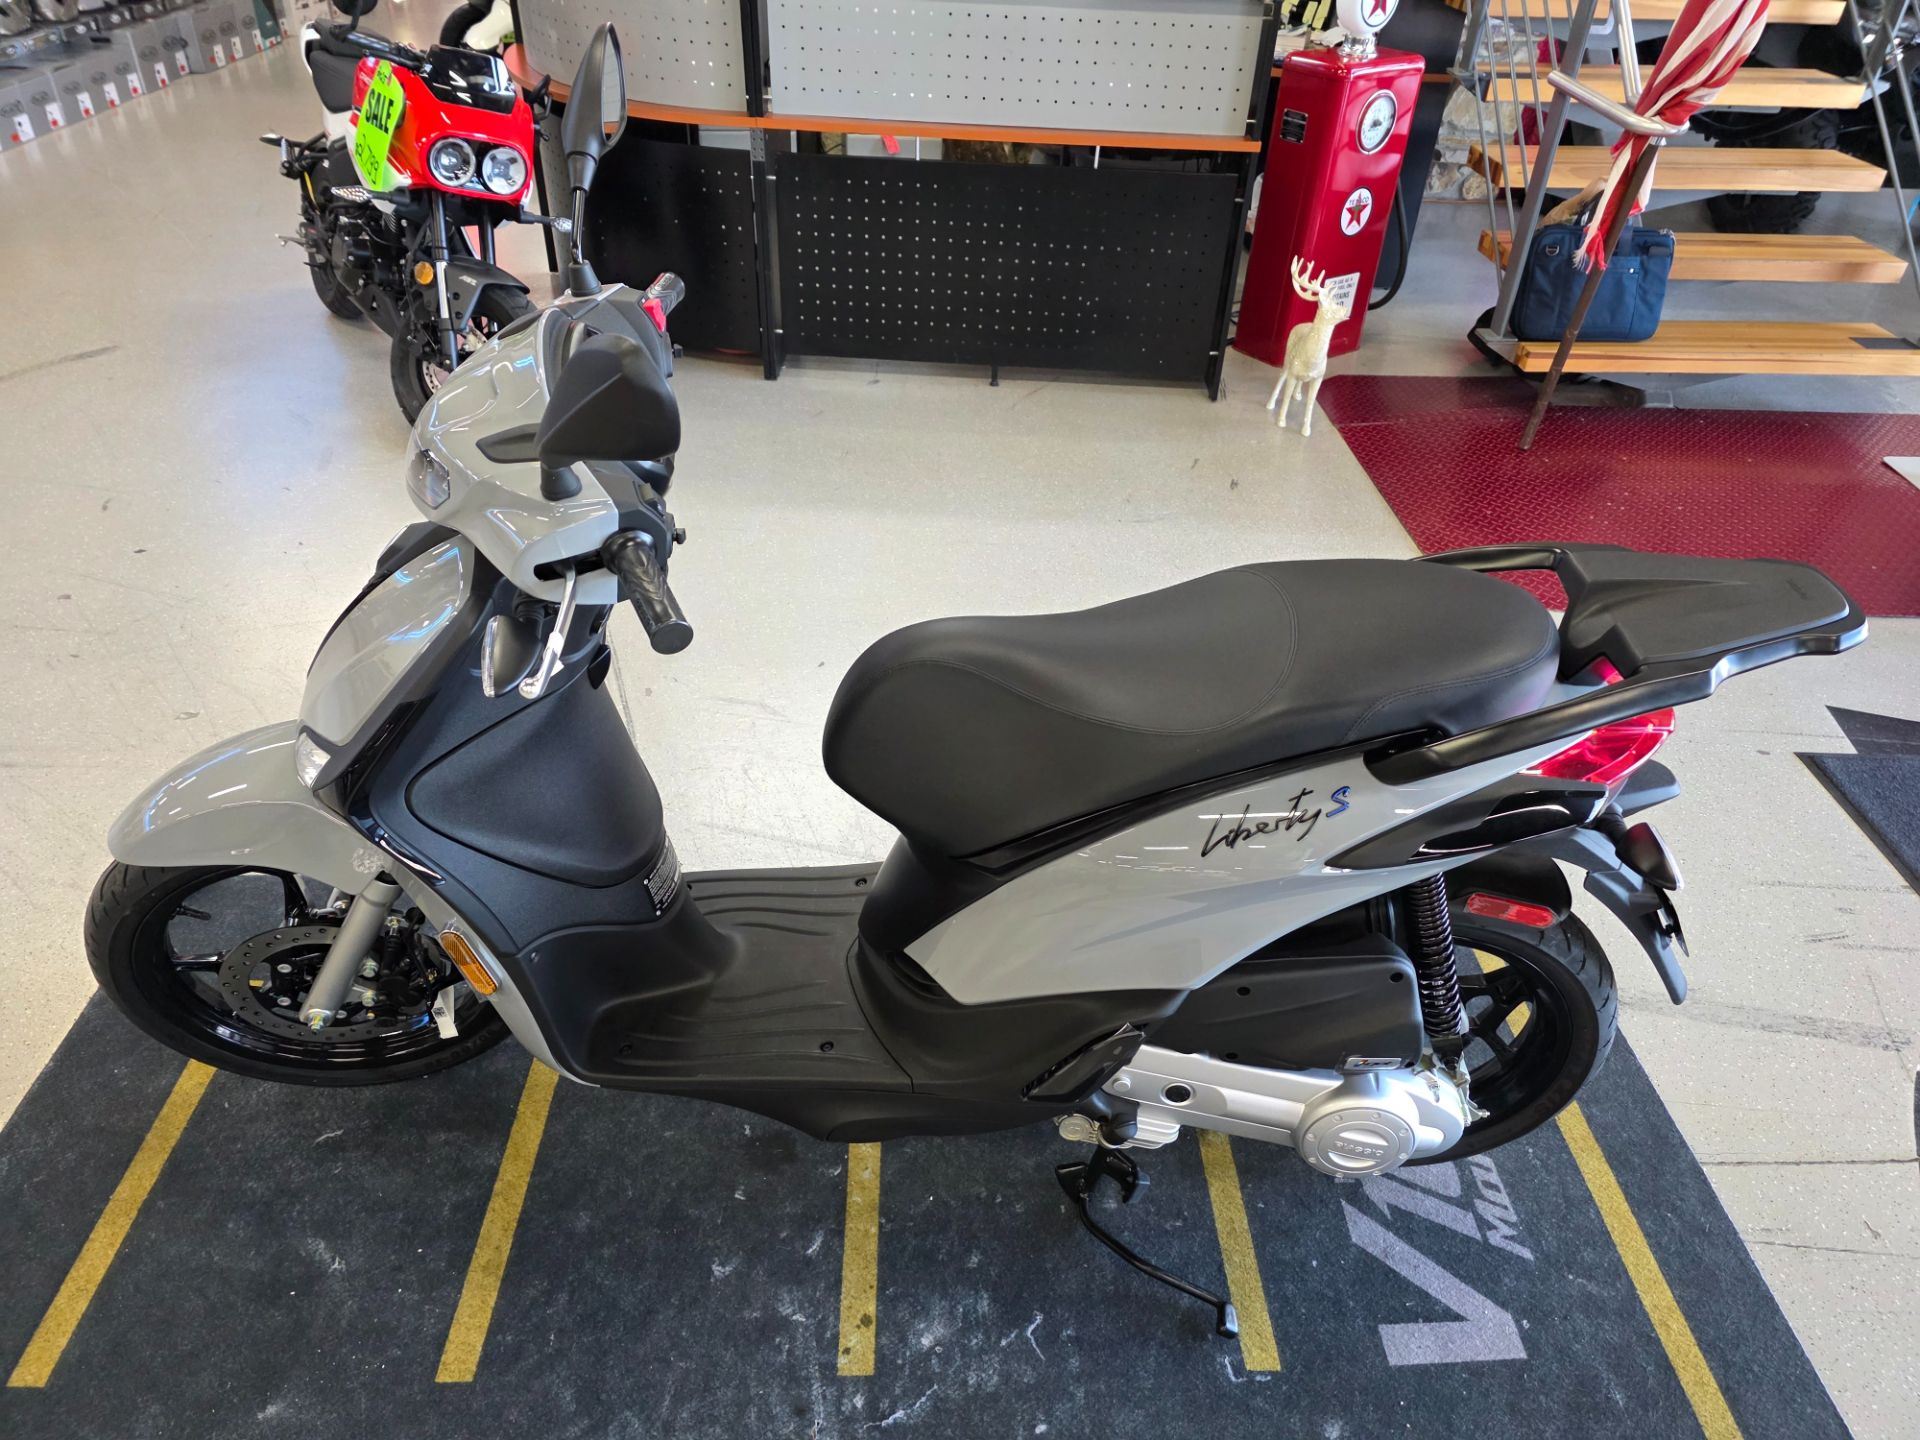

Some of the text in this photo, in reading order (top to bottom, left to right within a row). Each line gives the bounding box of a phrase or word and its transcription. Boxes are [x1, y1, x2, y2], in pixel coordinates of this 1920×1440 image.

[365, 88, 395, 134] SALE
[1201, 785, 1351, 858] Liberty S
